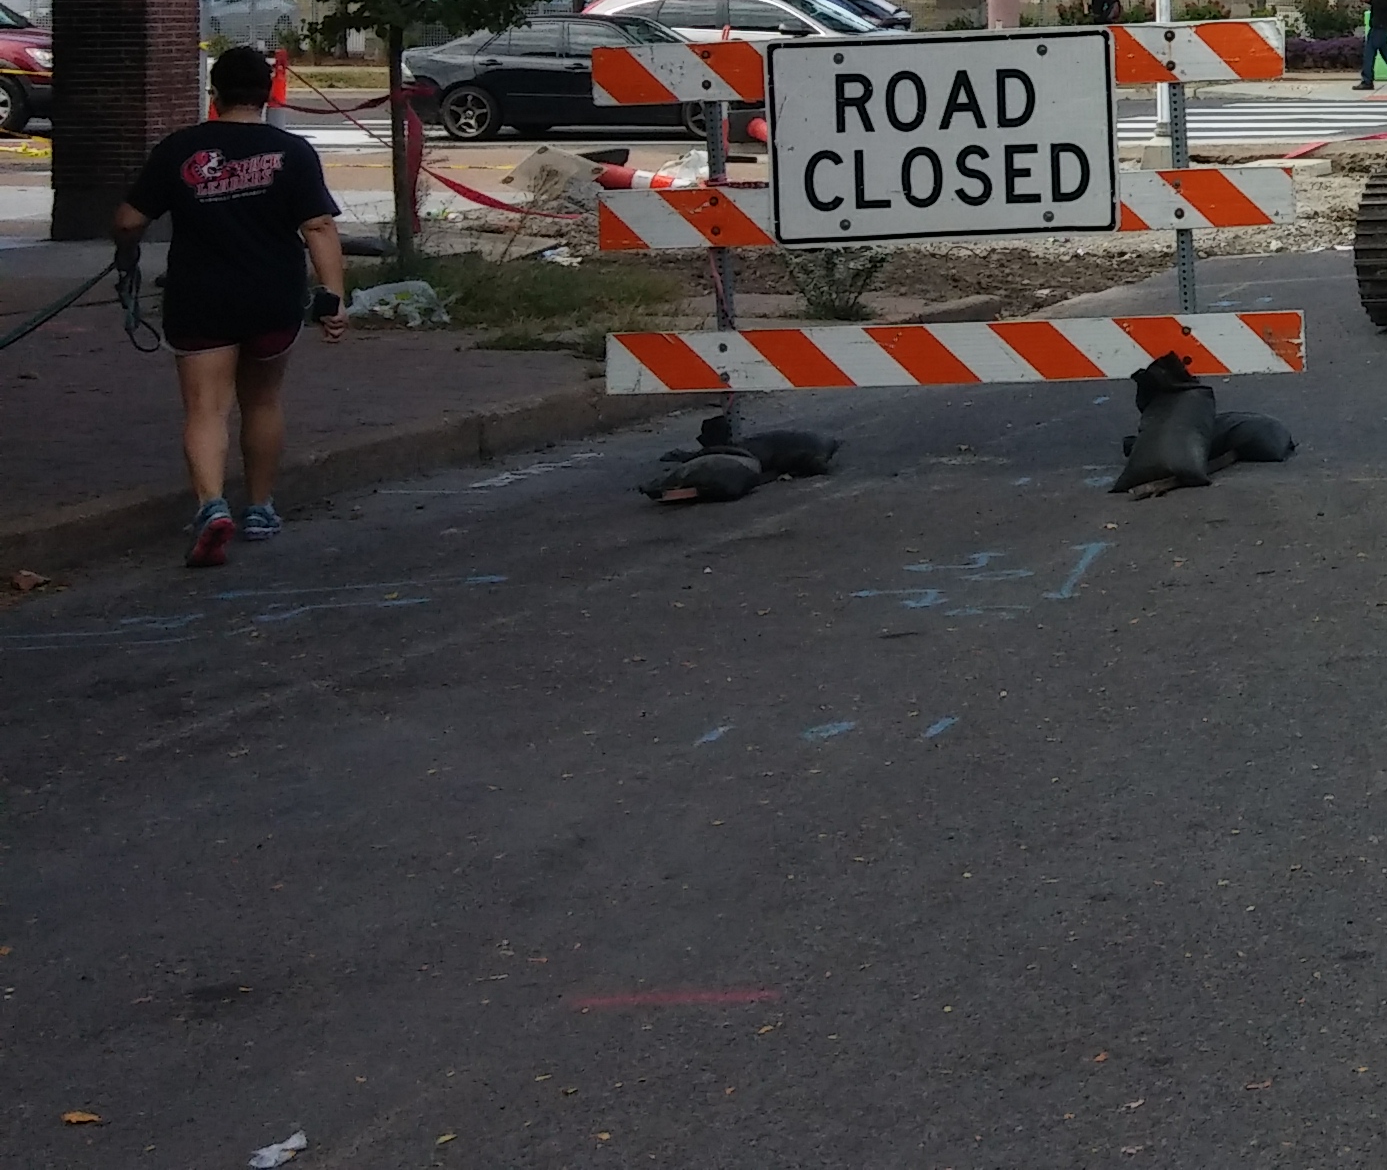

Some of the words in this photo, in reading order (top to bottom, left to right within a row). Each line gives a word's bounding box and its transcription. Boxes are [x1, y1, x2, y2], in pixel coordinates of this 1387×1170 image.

[835, 68, 1036, 133] ROAD
[196, 170, 273, 196] LEADERS
[804, 142, 1091, 212] CLOSED
